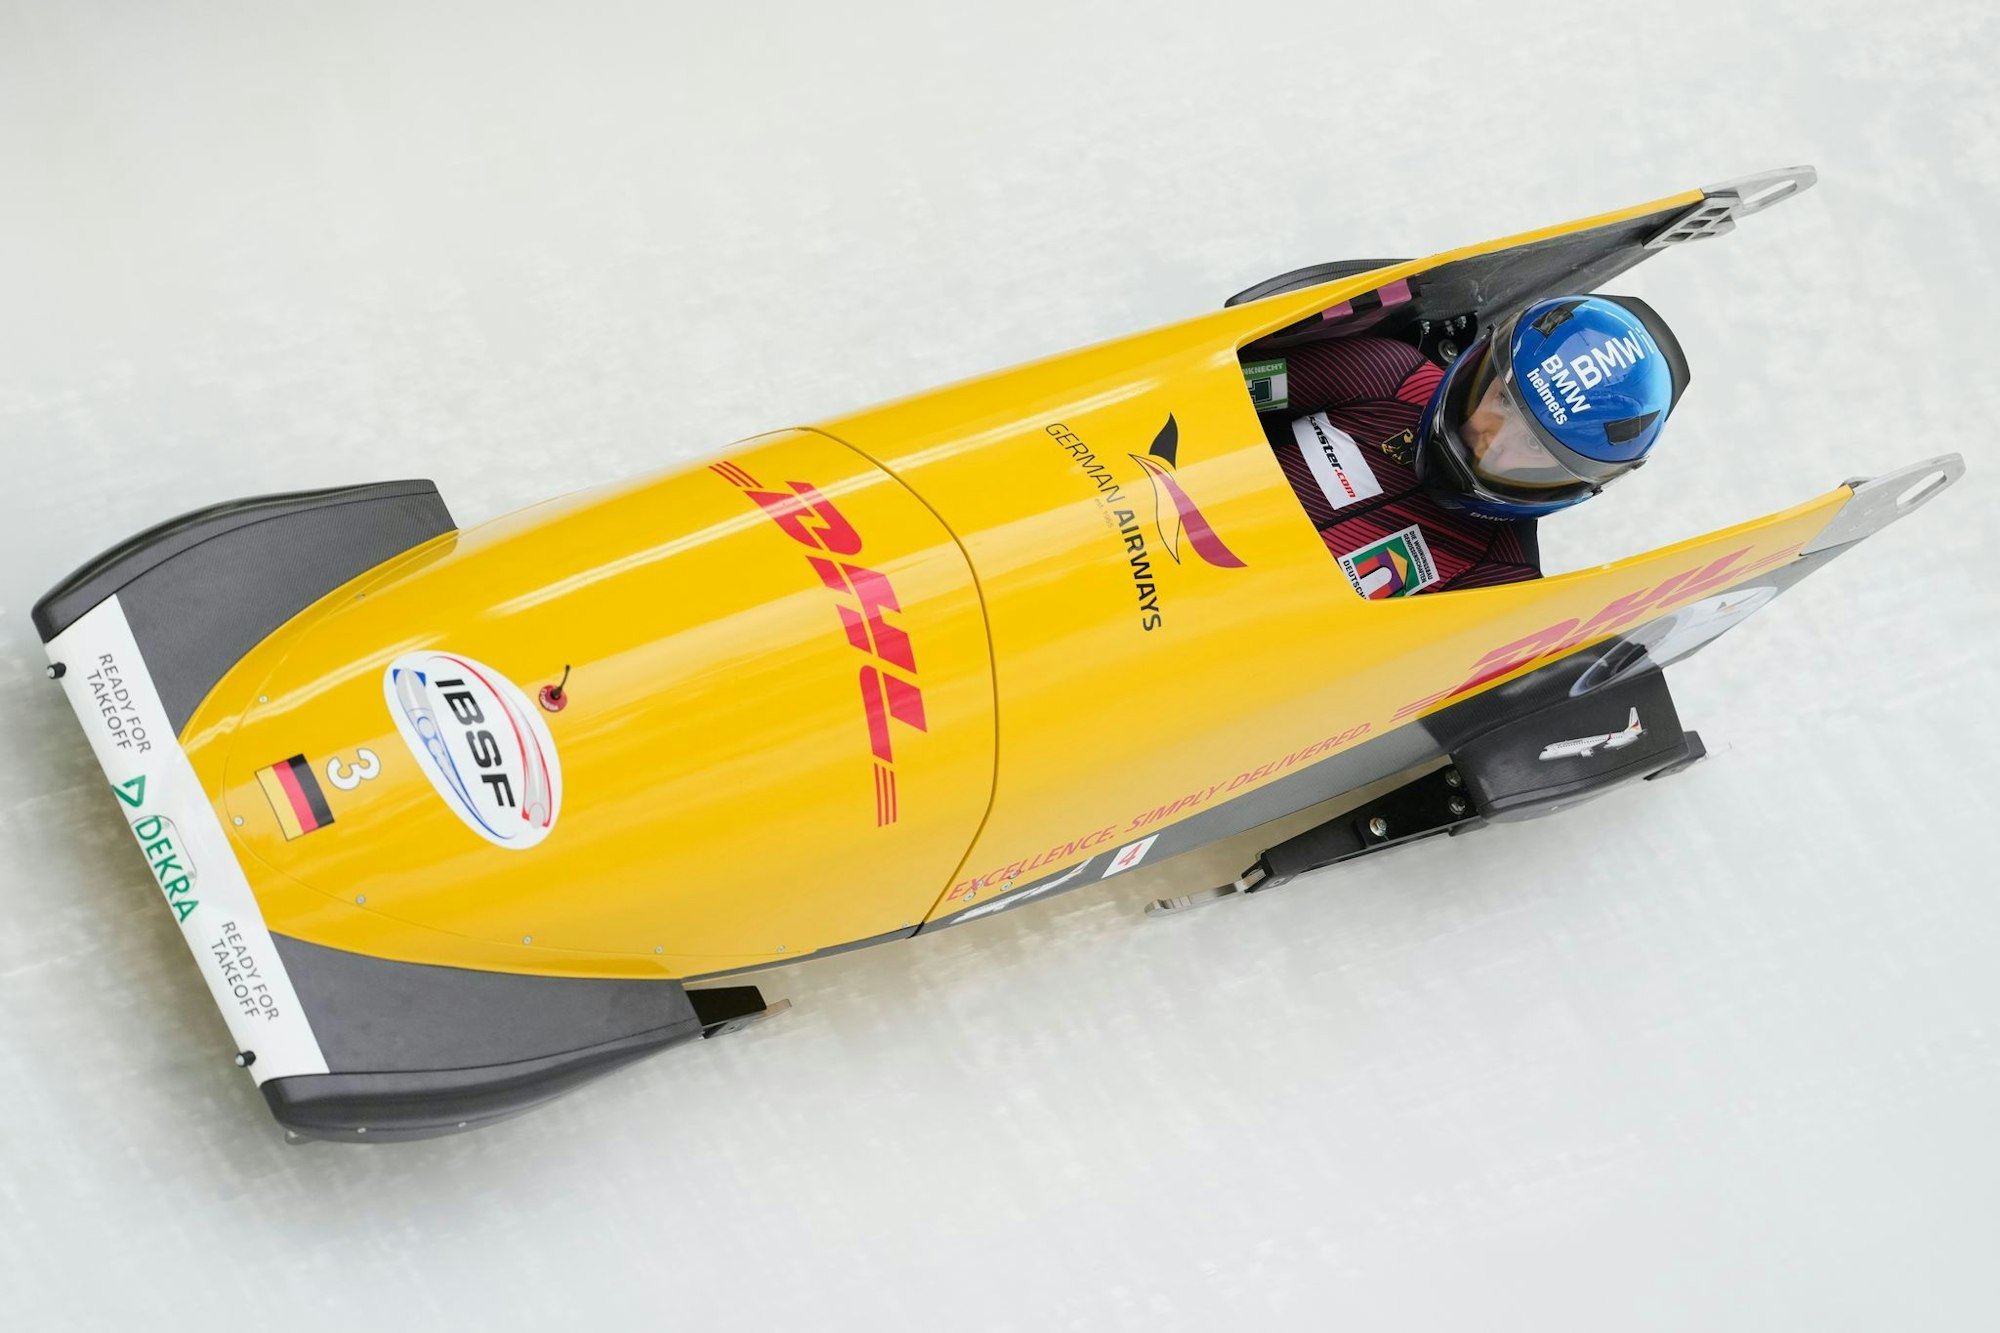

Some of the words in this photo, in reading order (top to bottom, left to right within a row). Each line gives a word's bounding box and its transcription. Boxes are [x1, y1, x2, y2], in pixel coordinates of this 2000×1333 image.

[1526, 367, 1568, 425] helmets
[1541, 354, 1591, 414] BMW
[1570, 329, 1645, 390] BMW
[1045, 423, 1125, 504] GERMAN
[1113, 509, 1162, 631] AIRWAYS
[744, 481, 928, 764] DHL
[1343, 559, 1367, 600] DEUTSCH
[1443, 545, 1756, 700] DHL
[87, 669, 132, 749] TAKEOFF
[98, 653, 135, 711] READY
[126, 716, 152, 754] FOR
[434, 678, 516, 807] IBSF
[326, 747, 382, 791] 3
[945, 825, 1117, 901] EXCELLENCE.
[1124, 781, 1227, 833] SIMPLY
[1226, 722, 1372, 792] DELIVERED.
[135, 815, 199, 923] DEKRA
[1117, 843, 1144, 866] 4
[211, 938, 261, 1017] TAKEOFF
[221, 921, 261, 979] READY
[253, 983, 280, 1021] FOR
